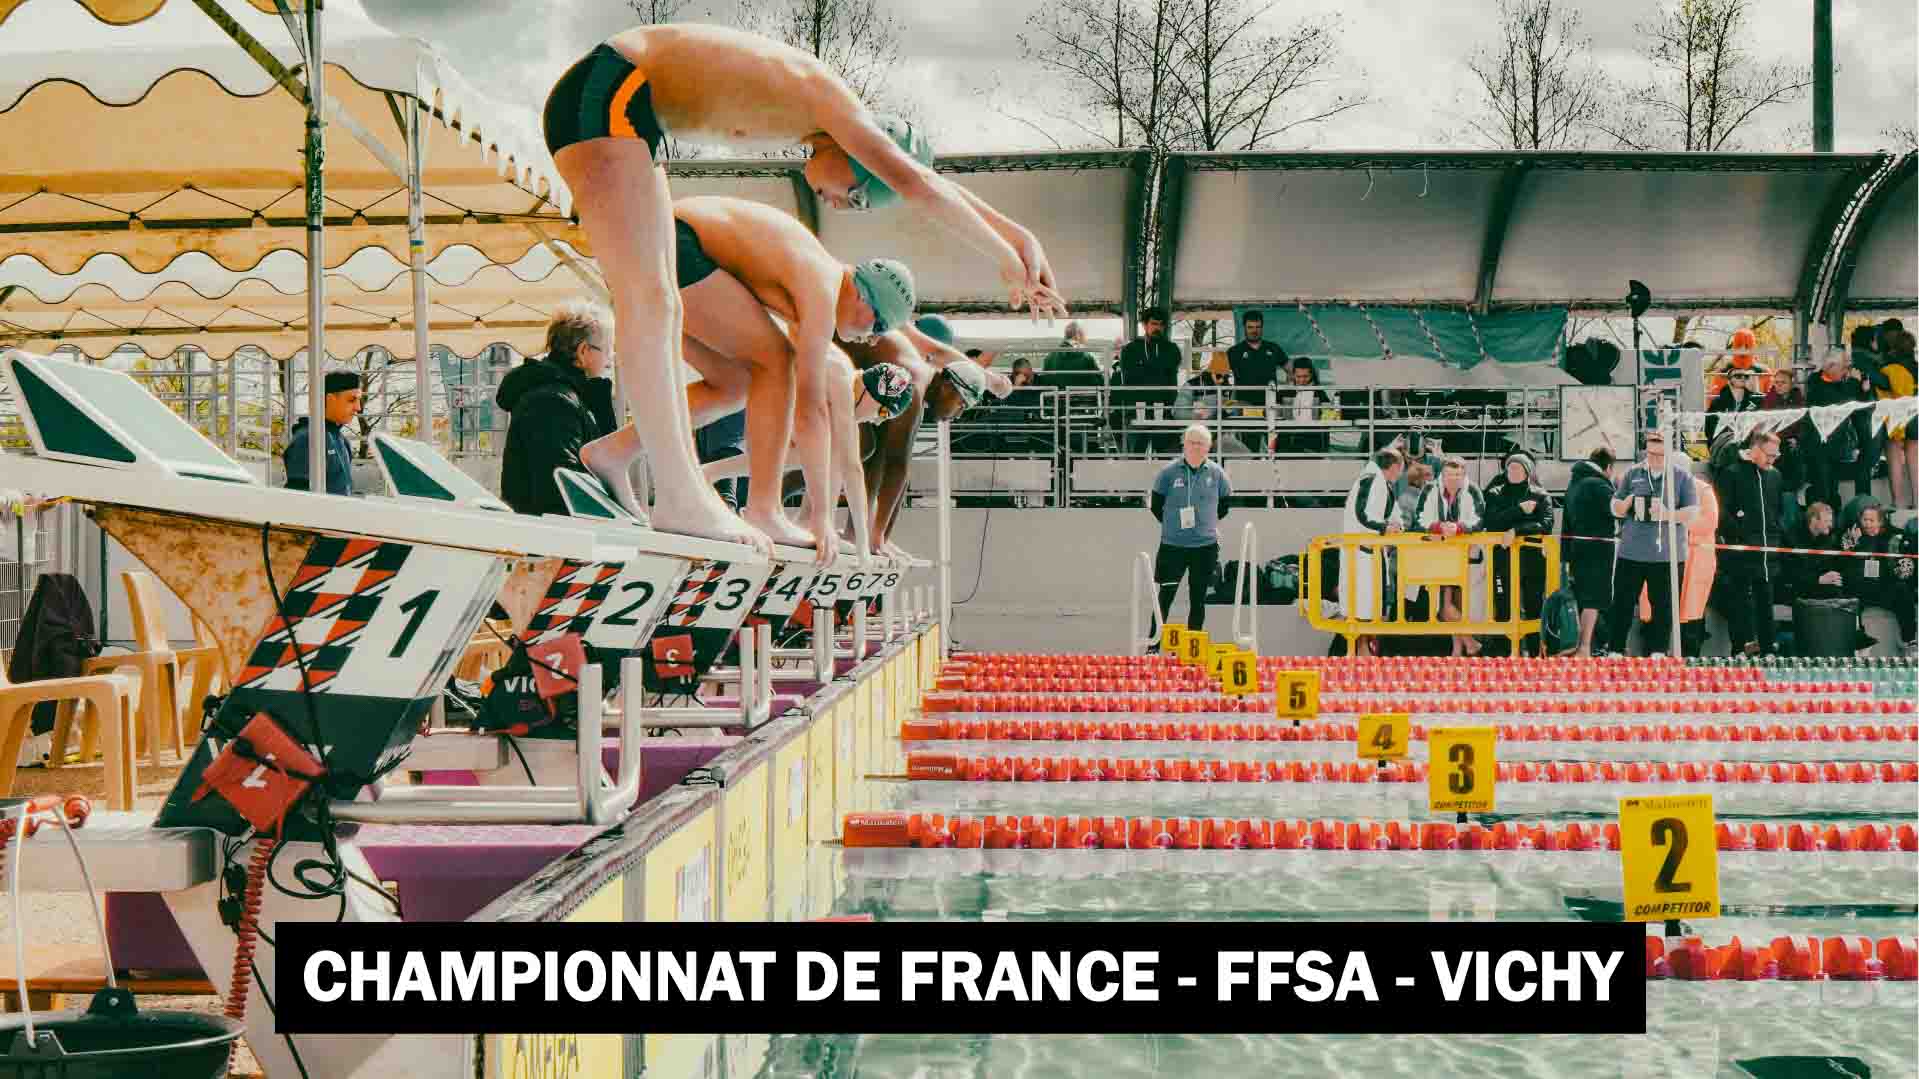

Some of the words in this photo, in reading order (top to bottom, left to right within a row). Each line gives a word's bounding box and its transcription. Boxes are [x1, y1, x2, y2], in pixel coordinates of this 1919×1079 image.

[776, 576, 802, 601] 4
[818, 574, 841, 595] 5
[846, 572, 865, 591] 6
[866, 573, 882, 588] 7
[883, 573, 899, 587] 8
[601, 580, 654, 625] 2
[714, 578, 751, 611] 3
[389, 589, 440, 658] 1
[1169, 630, 1178, 647] 8
[1233, 660, 1247, 686] 6
[1289, 681, 1306, 709] 5
[1372, 723, 1396, 749] 4
[1448, 744, 1474, 794] 3
[1651, 817, 1691, 893] 2
[1633, 901, 1712, 916] COMPETITOR
